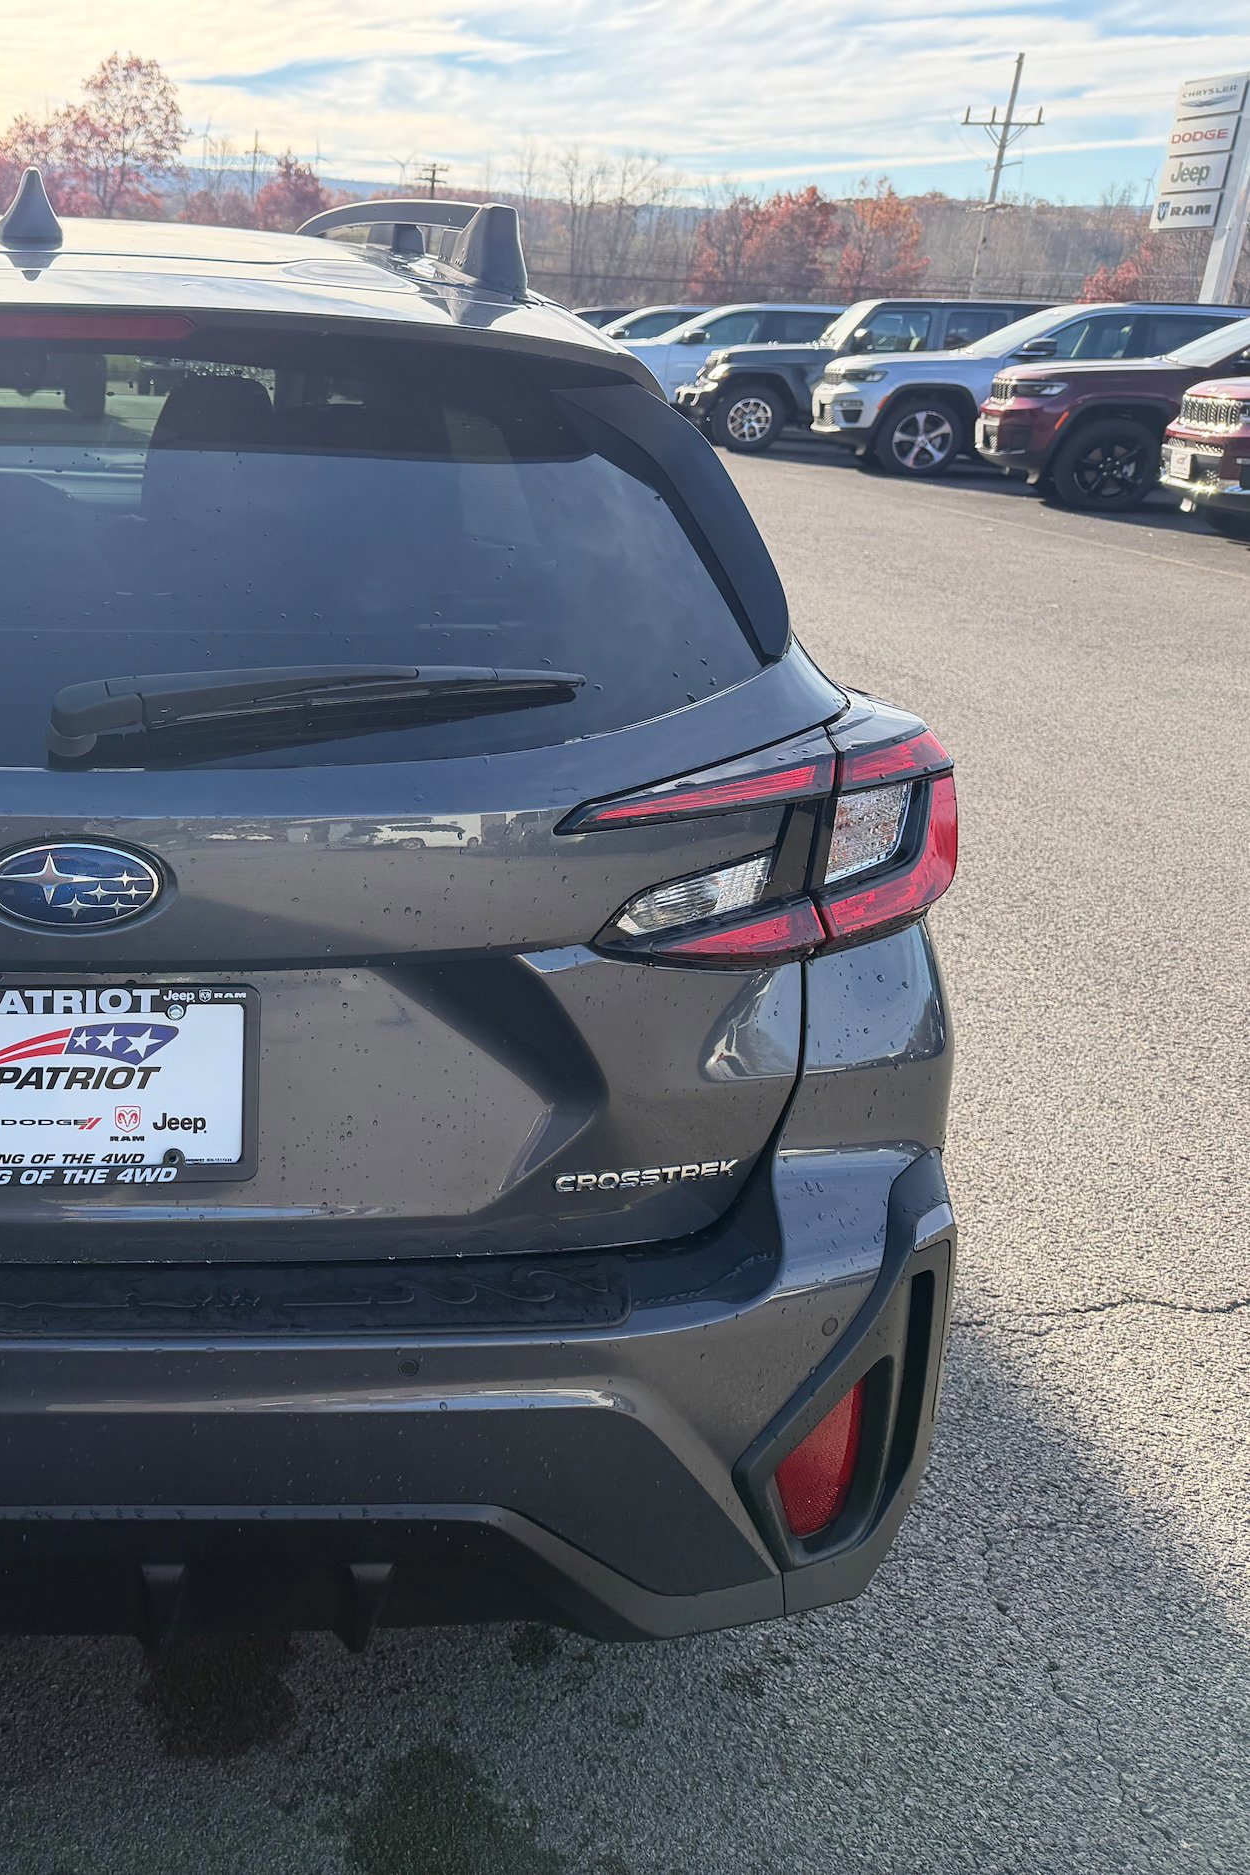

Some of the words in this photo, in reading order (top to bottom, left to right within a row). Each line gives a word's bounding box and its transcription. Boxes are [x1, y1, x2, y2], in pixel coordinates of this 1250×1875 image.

[1182, 84, 1238, 98] CHRYSLER
[1171, 128, 1229, 144] DODGE
[1170, 161, 1210, 186] Jeep
[1170, 204, 1212, 216] RAM
[163, 989, 196, 1003] Jeep
[152, 1112, 207, 1134] Jeep
[30, 1153, 56, 1165] OF
[62, 1153, 95, 1164] THE
[101, 1153, 145, 1164] 4WD
[19, 1169, 56, 1185] OF
[63, 1168, 110, 1184] THE
[116, 1167, 178, 1183] 4WD
[554, 1159, 738, 1192] CROSSTREK
